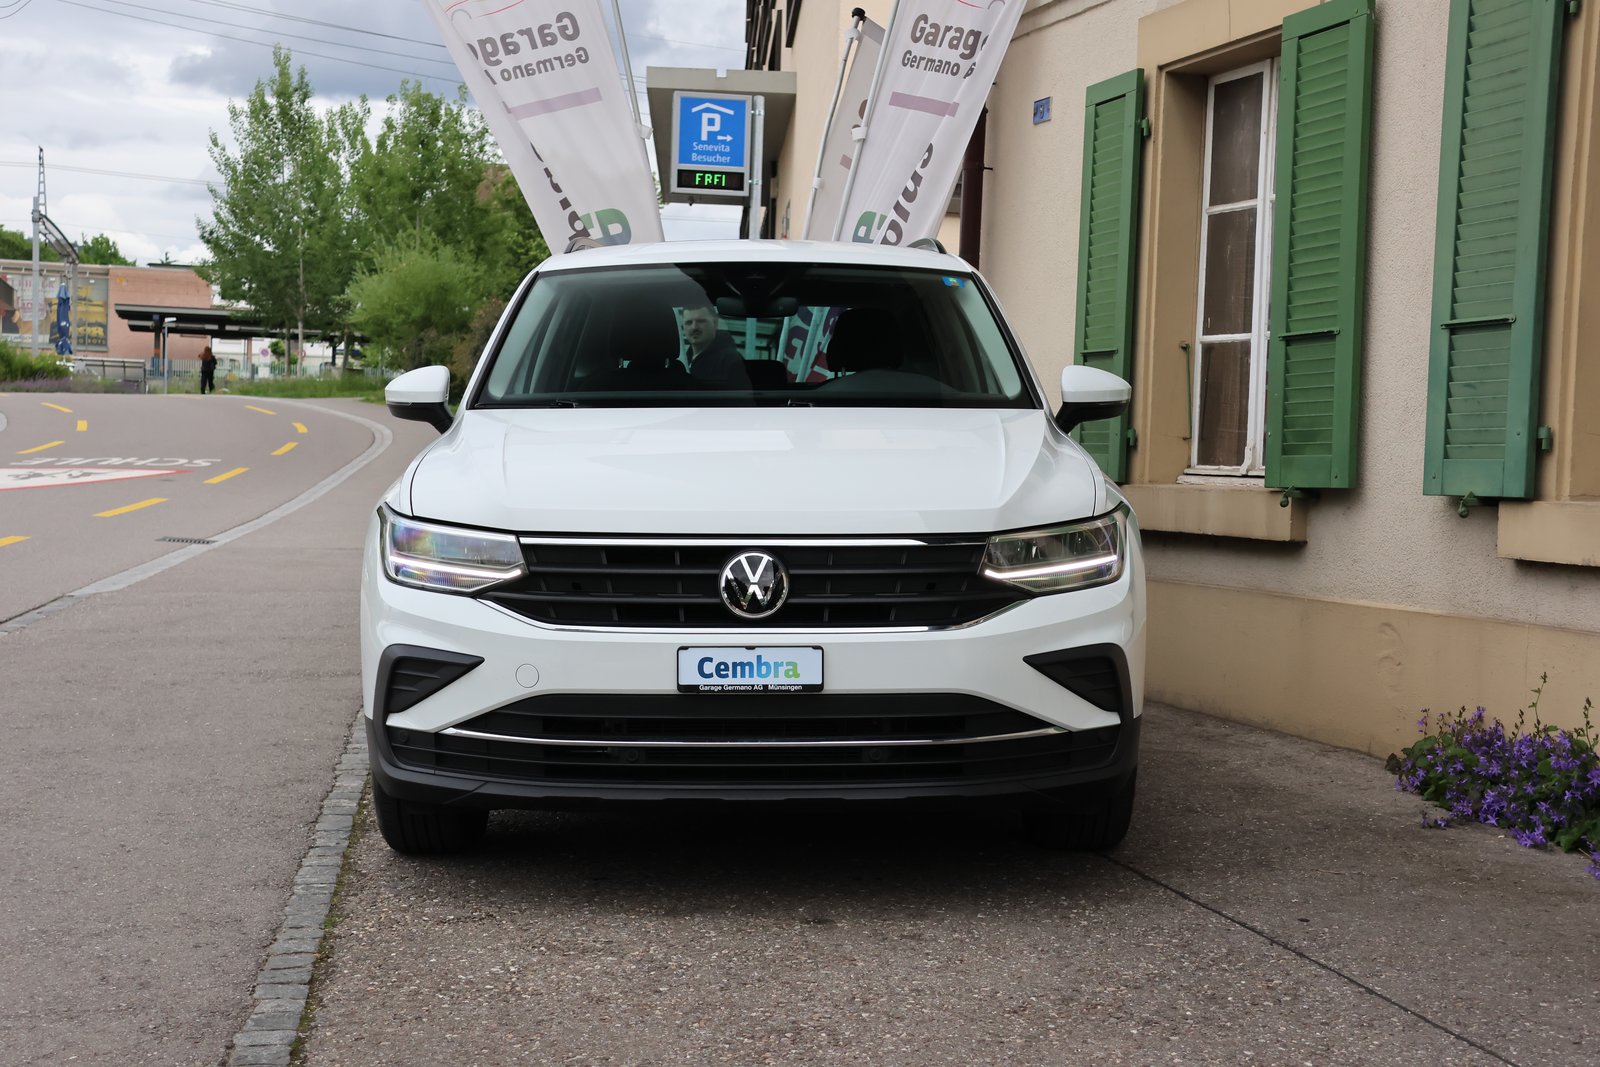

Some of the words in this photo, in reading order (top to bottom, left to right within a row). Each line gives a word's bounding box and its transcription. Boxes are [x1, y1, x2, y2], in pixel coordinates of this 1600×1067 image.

[901, 49, 961, 77] Germano
[701, 112, 721, 141] P
[693, 142, 730, 152] Senevita
[691, 153, 730, 163] Besucher
[9, 456, 222, 468] SCHULE
[697, 654, 801, 679] Cembra
[699, 684, 722, 692] Garage
[768, 684, 803, 692] Münsingen
